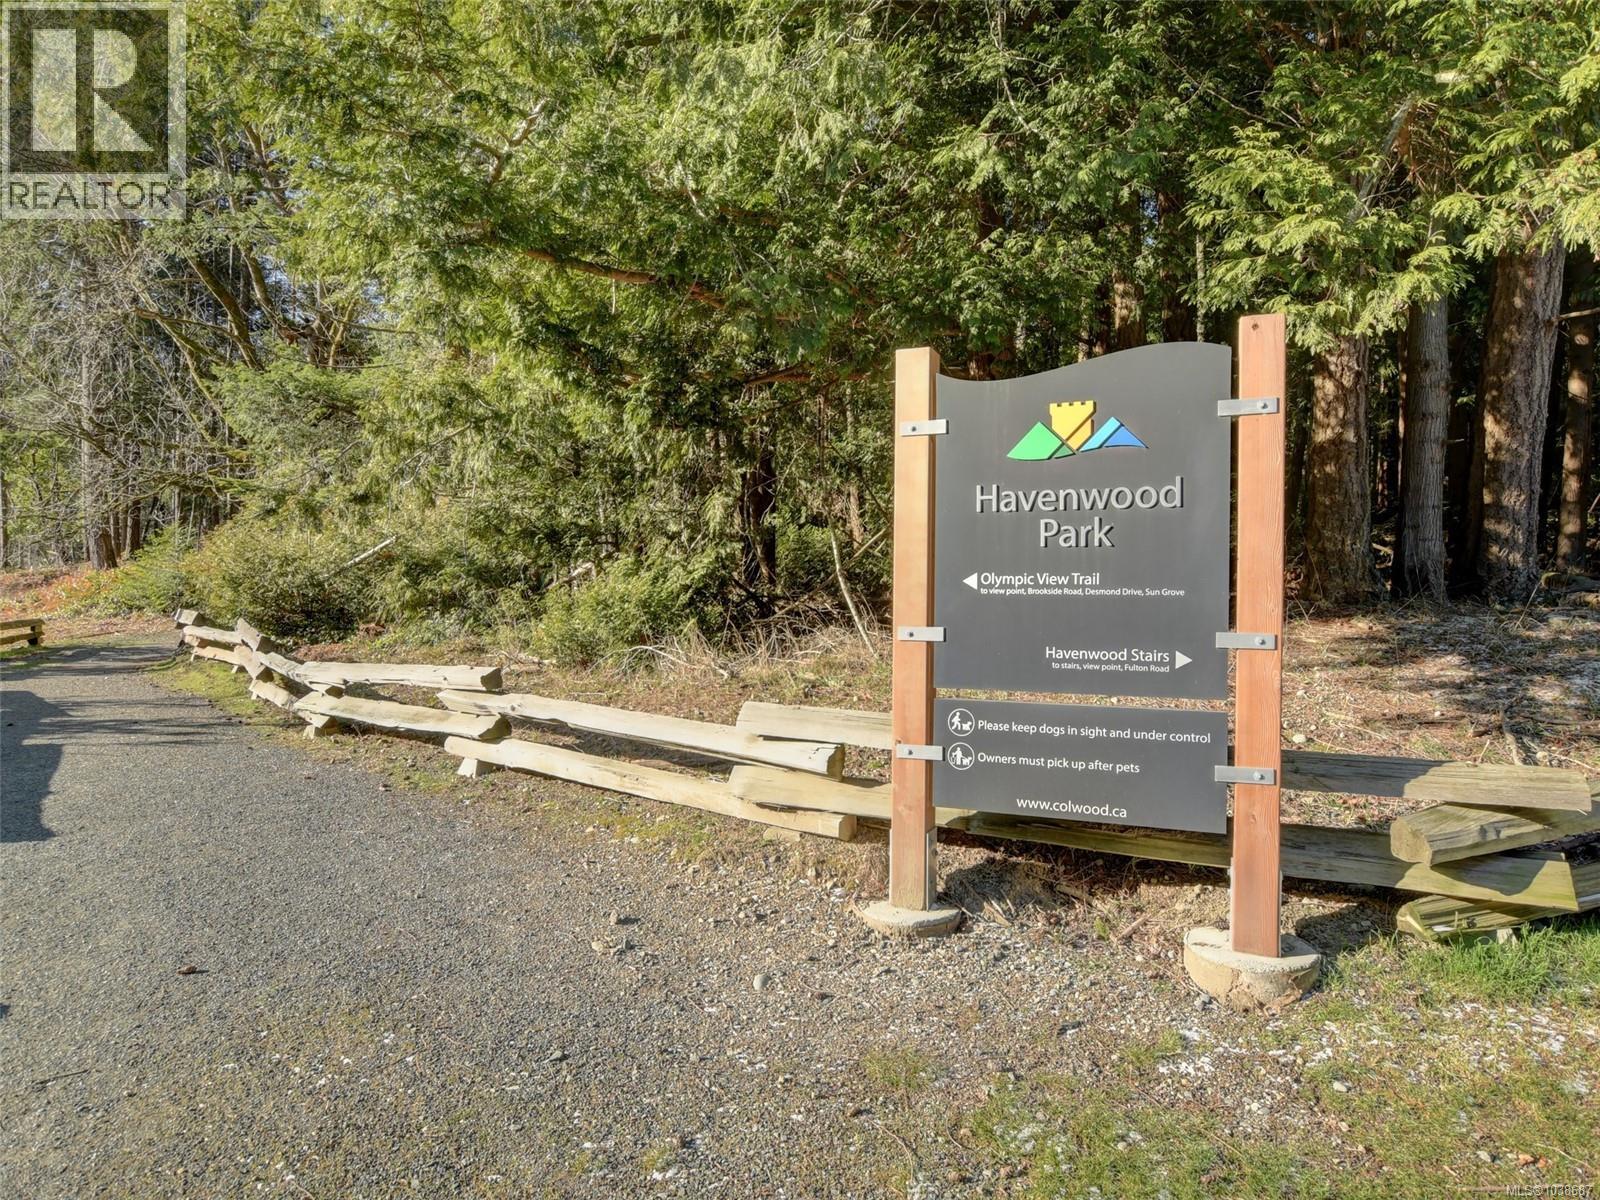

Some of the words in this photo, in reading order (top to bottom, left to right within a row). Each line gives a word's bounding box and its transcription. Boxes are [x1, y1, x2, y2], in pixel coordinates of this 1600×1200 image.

[975, 475, 1184, 513] Havenwood
[1039, 516, 1115, 548] Park
[980, 572, 1035, 588] Olympic
[1036, 572, 1070, 585] View
[1071, 572, 1100, 585] Trail
[980, 587, 989, 595] to
[989, 587, 1006, 595] view
[1006, 587, 1027, 596] point,
[1028, 587, 1063, 595] Brookside
[1063, 587, 1084, 596] Road,
[1085, 587, 1121, 596] Desmond
[1122, 587, 1144, 596] Drive,
[1145, 587, 1160, 596] Sun
[1161, 588, 1185, 597] Grove
[1045, 646, 1128, 661] Havenwood
[1131, 648, 1170, 662] Stairs
[1052, 661, 1060, 669] to
[1060, 662, 1082, 670] stairs,
[1083, 662, 1100, 671] view
[1101, 663, 1123, 672] point,
[1124, 663, 1149, 672] Fulton
[1149, 664, 1170, 673] Road
[977, 719, 1010, 732] Please
[1011, 721, 1037, 735] keep
[1039, 723, 1065, 737] dogs
[1067, 725, 1078, 736] in
[1080, 726, 1107, 739] sight
[1109, 728, 1131, 739] and
[1133, 729, 1167, 741] under
[1169, 732, 1211, 744] control
[977, 752, 1017, 765] Owners
[1018, 755, 1045, 767] must
[1047, 757, 1069, 769] pick
[1071, 761, 1086, 772] up
[1088, 759, 1114, 771] after
[1116, 763, 1140, 775] pets
[1016, 798, 1127, 818] www.colwood.ca
